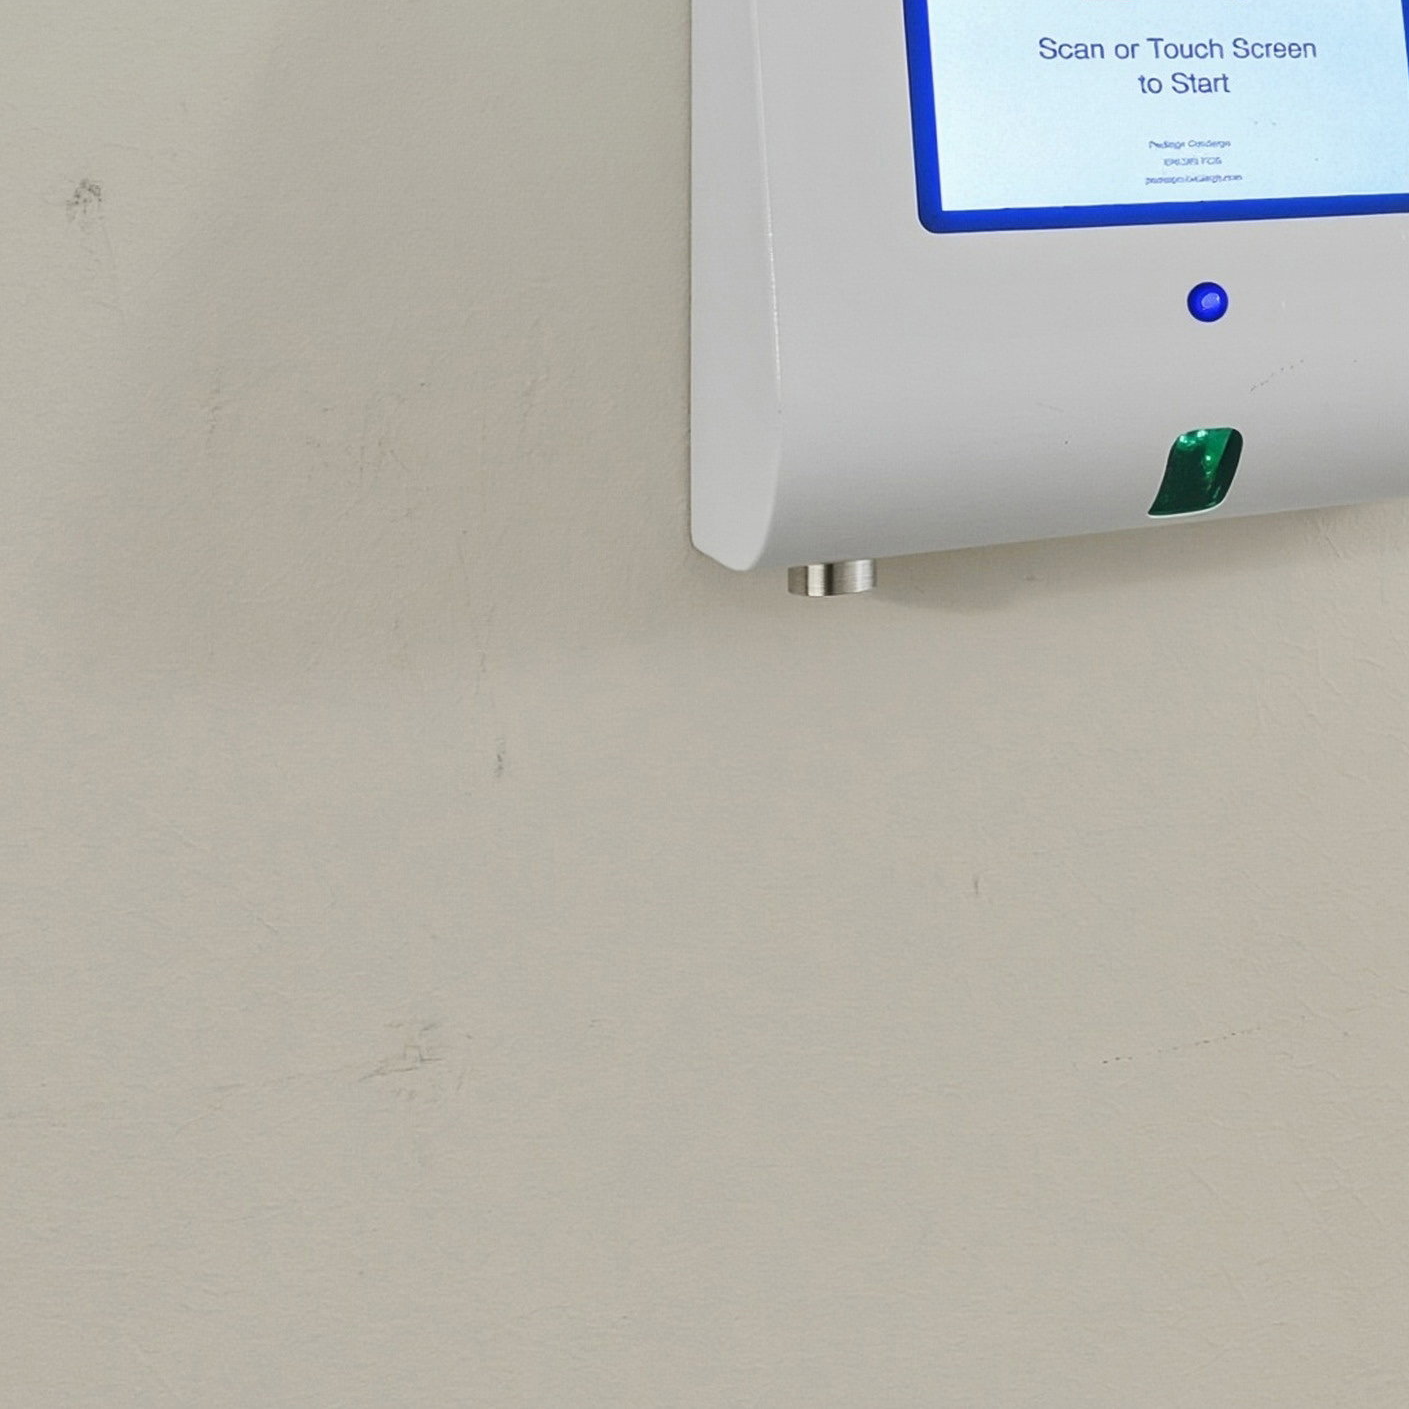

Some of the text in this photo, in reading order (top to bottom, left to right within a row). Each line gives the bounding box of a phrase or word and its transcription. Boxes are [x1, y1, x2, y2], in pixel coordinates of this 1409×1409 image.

[1038, 37, 1317, 60] Scan or Touch Screen
[1138, 72, 1231, 94] to Start
